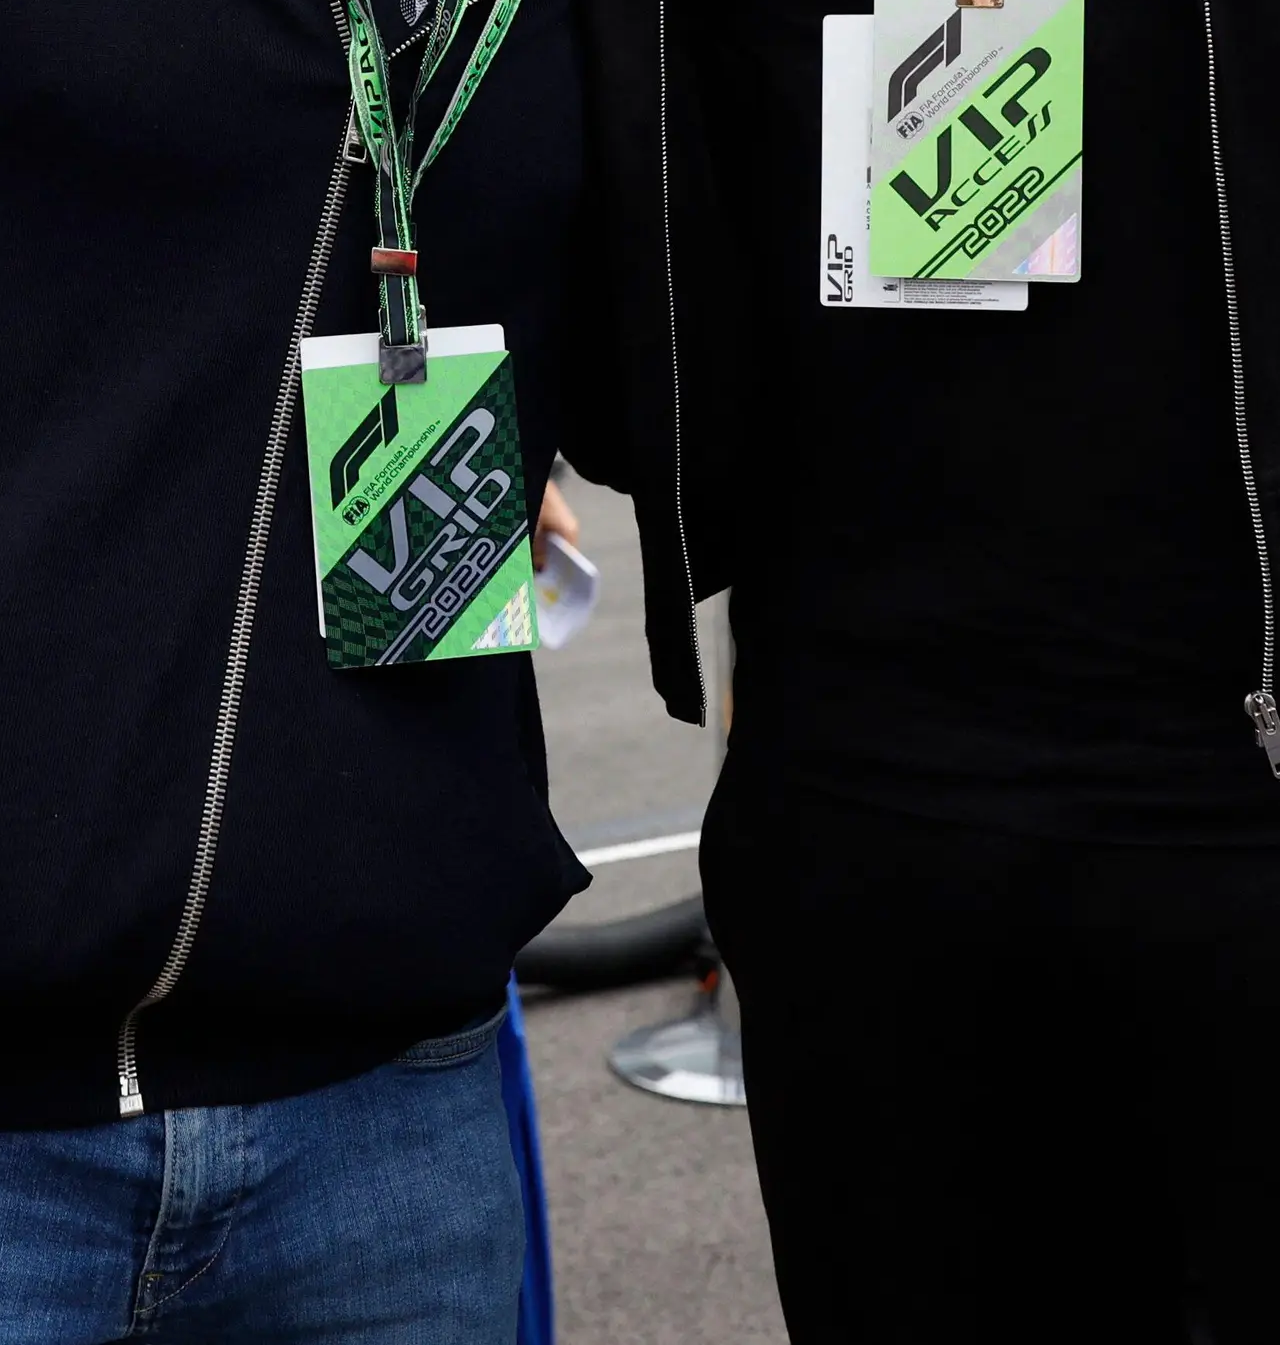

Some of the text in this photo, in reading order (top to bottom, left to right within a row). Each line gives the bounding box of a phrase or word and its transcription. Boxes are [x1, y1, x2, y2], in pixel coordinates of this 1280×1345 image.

[924, 97, 949, 119] World
[931, 69, 964, 101] Formula
[889, 47, 1052, 218] VIP
[924, 100, 1052, 232] ACCESS
[960, 165, 1046, 261] 2022
[826, 233, 844, 303] VIP
[844, 245, 854, 304] GRID
[346, 407, 496, 595] VIP
[369, 478, 393, 502] World
[374, 449, 405, 483] Formula
[390, 469, 512, 612] GRID
[420, 537, 497, 642] 2022
